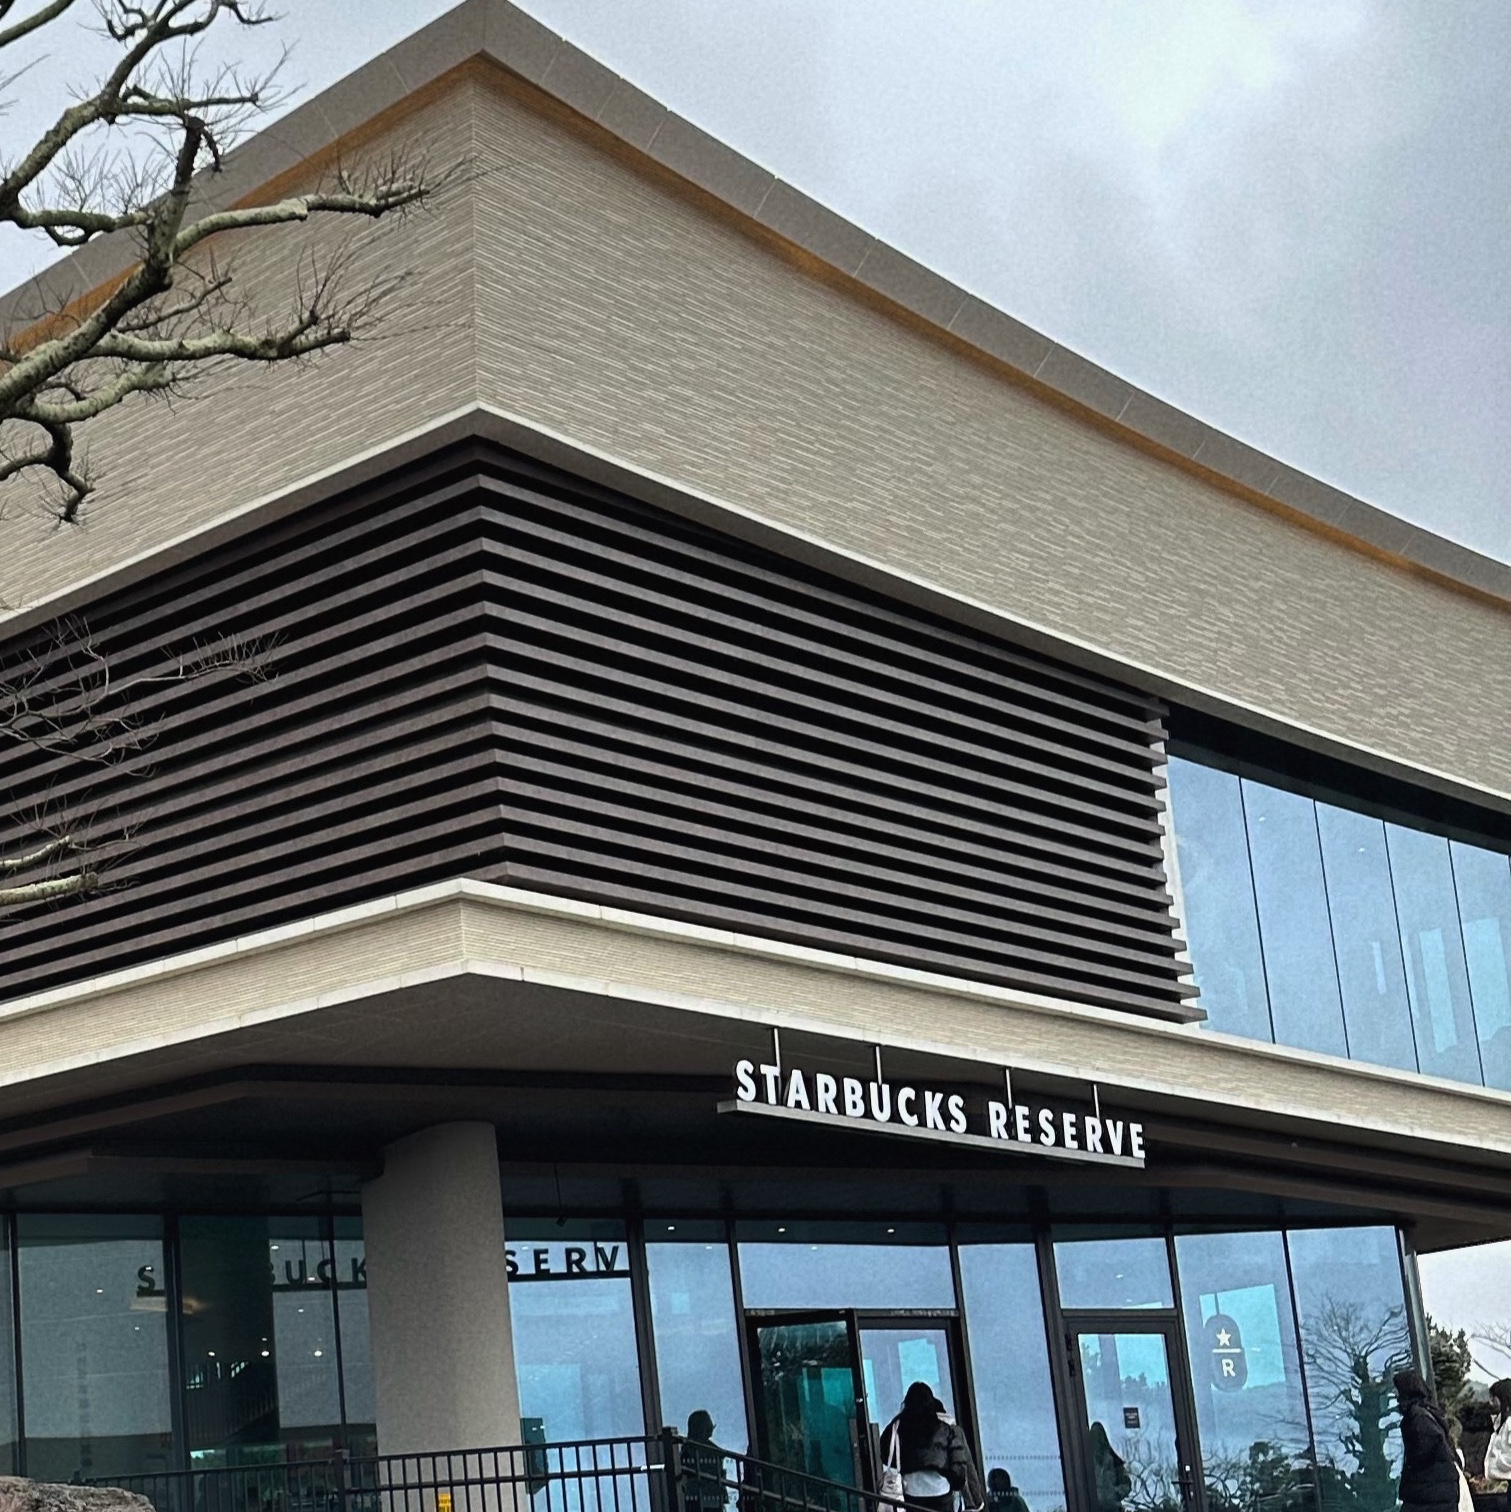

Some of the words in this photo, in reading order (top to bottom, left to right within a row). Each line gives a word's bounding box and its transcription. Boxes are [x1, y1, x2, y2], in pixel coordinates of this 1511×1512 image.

[735, 1059, 967, 1134] STARBUCKS
[988, 1100, 1146, 1159] RESERVE
[1221, 1358, 1236, 1377] R
